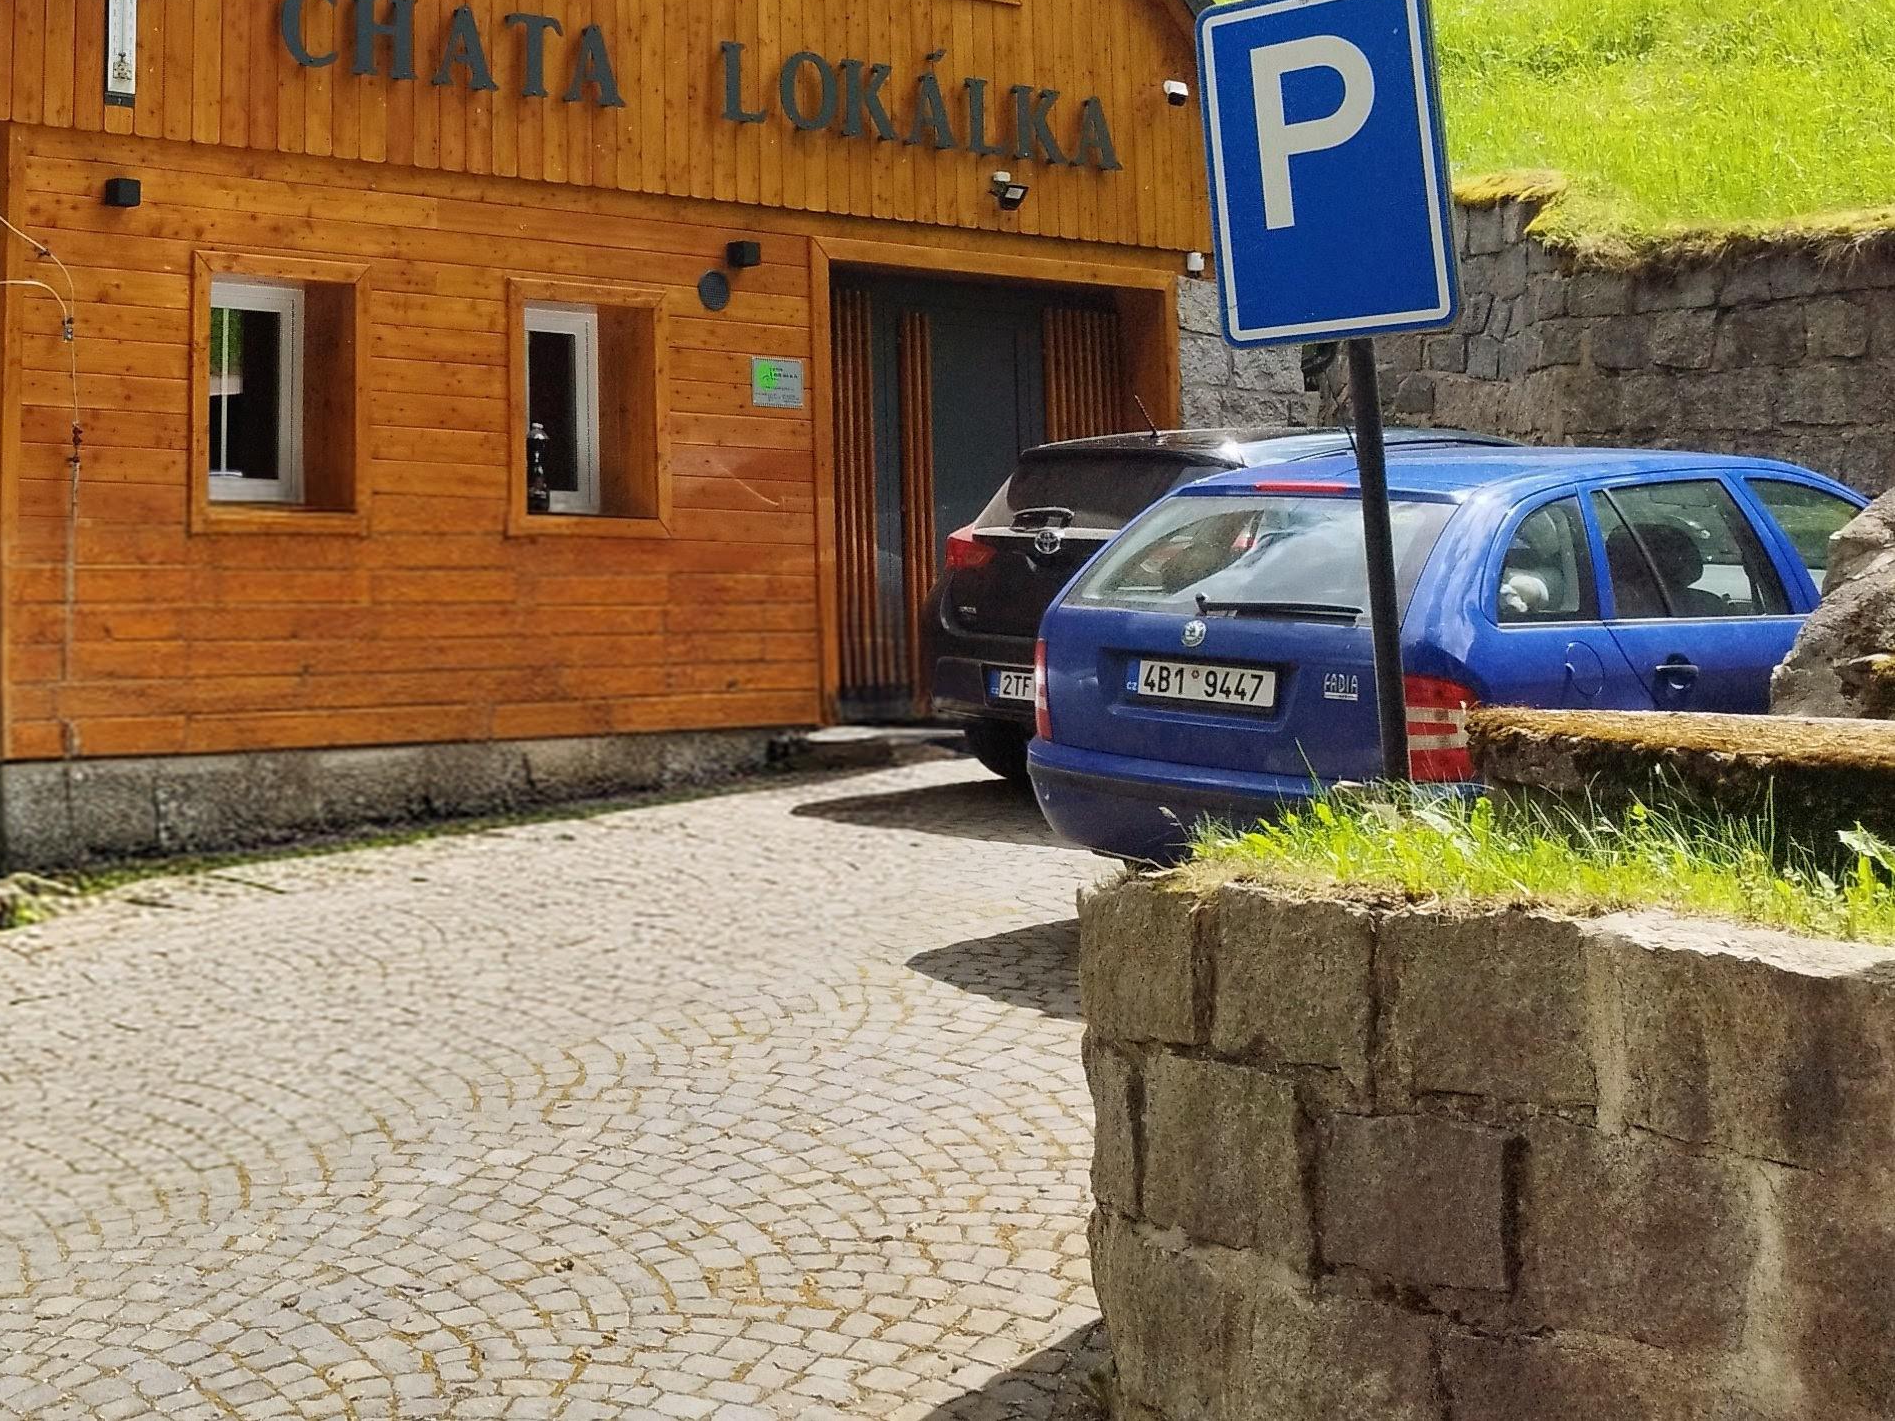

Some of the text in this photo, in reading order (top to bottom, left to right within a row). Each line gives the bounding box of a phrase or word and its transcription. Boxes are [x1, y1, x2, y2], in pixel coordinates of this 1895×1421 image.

[720, 41, 1123, 171] LOKÁLKA
[1250, 34, 1375, 230] P
[1003, 675, 1032, 696] 2TF
[1144, 665, 1264, 702] 4B1 9447
